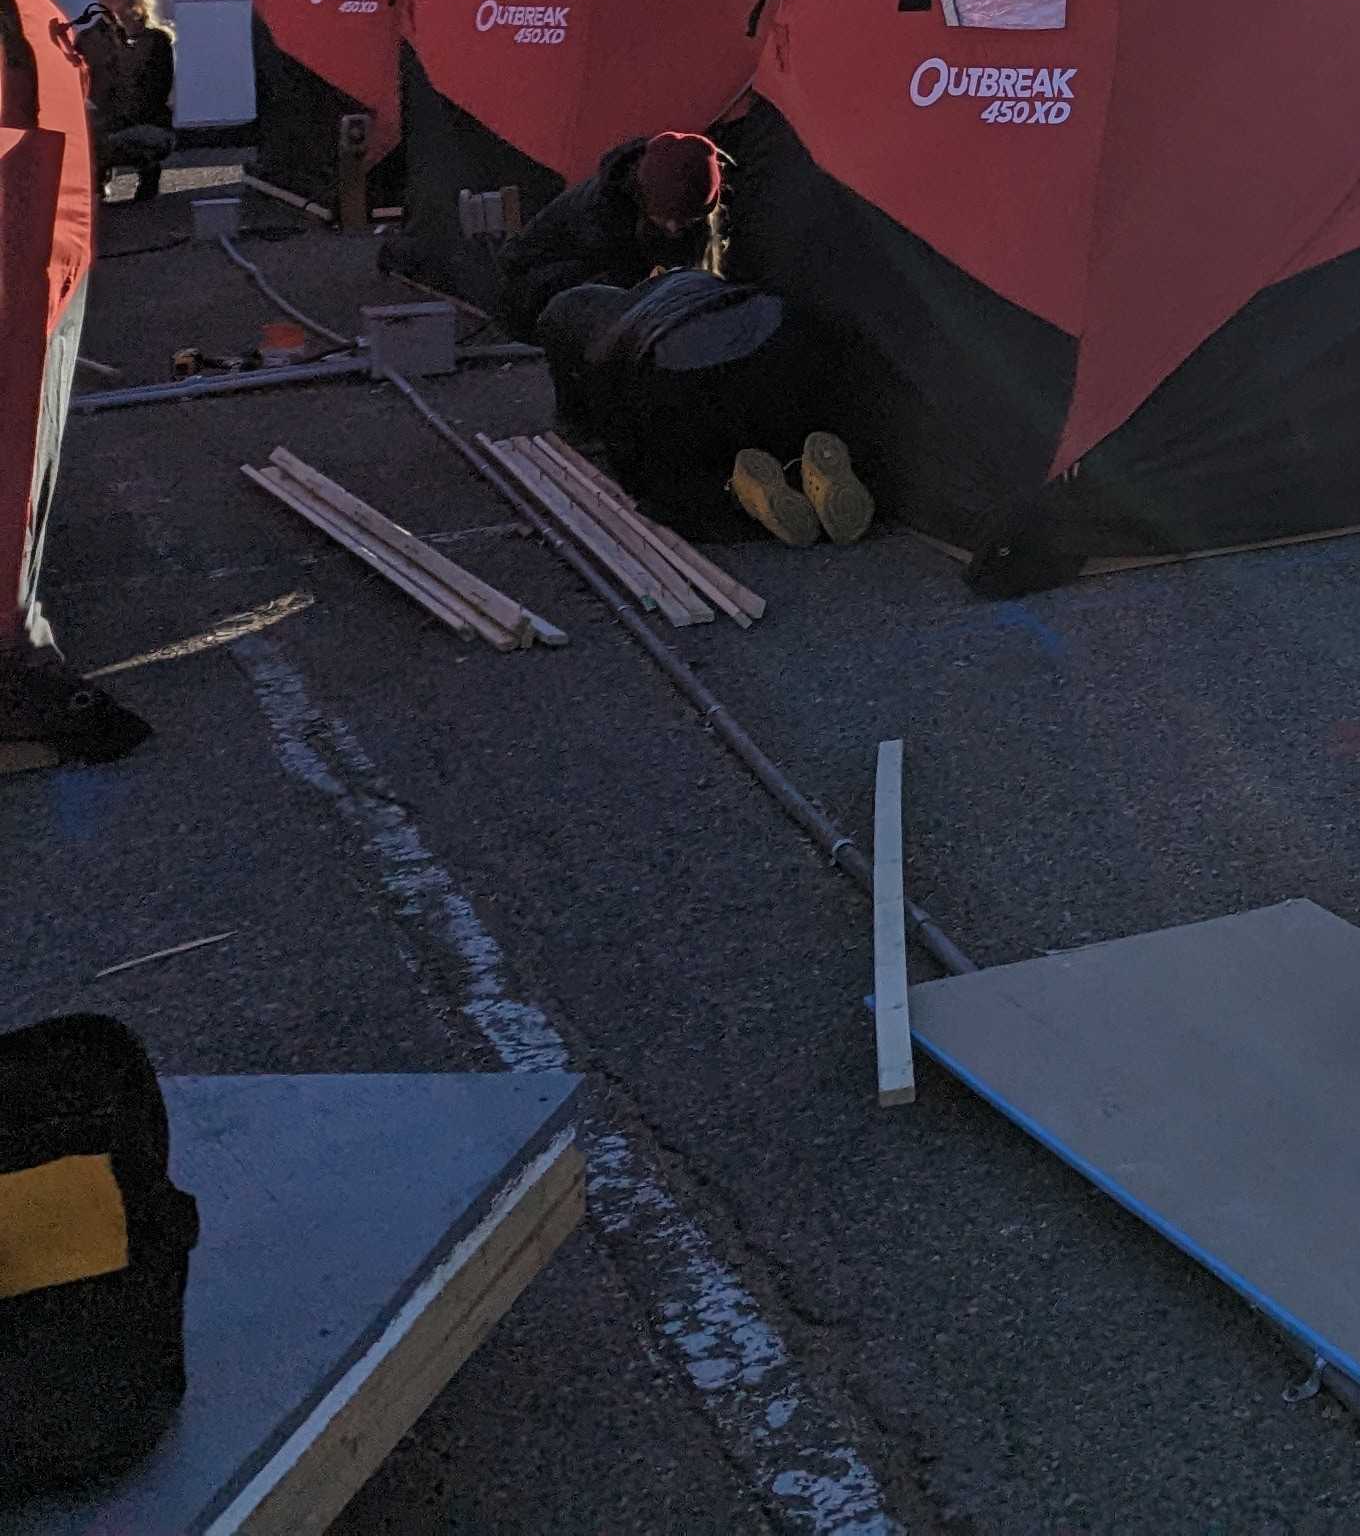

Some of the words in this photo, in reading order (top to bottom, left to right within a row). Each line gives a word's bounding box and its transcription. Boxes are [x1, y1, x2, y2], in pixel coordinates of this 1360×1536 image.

[475, 0, 571, 32] OUTBREAK
[513, 27, 566, 44] 450XD
[909, 56, 1078, 107] OUTBREAK
[980, 100, 1072, 125] 450XD
